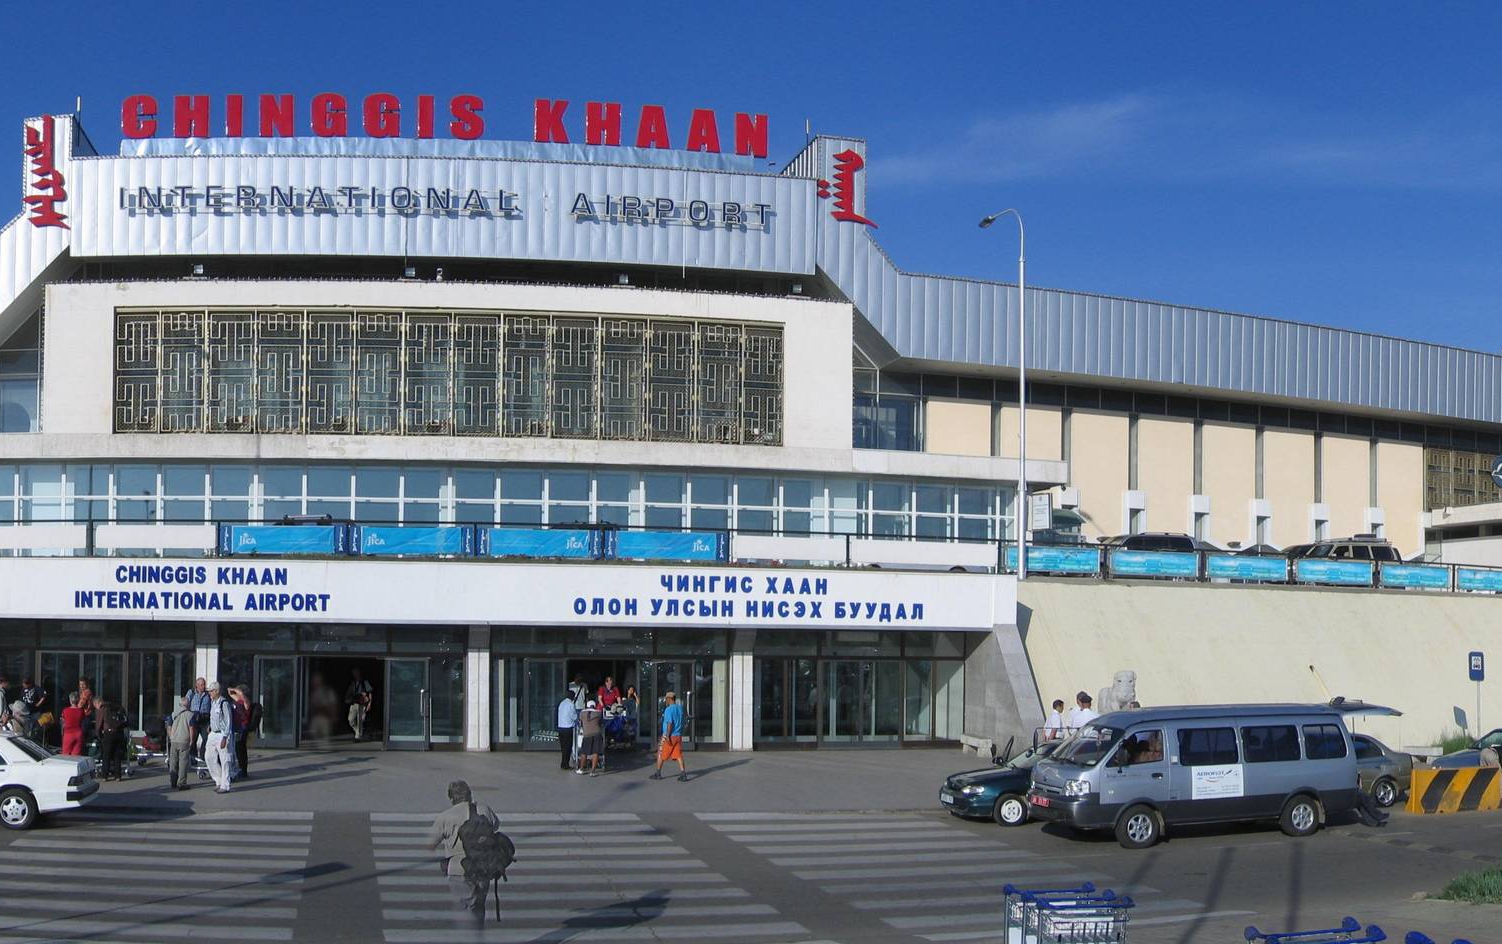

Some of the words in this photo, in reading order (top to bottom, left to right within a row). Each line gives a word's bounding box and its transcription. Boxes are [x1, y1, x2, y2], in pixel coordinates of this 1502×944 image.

[121, 92, 486, 141] CHINGGIS
[533, 98, 769, 158] KHAAN
[119, 185, 517, 212] INTERNATIONAL
[571, 191, 772, 226] AIRPORT
[115, 565, 207, 584] CHINGGIS
[217, 567, 288, 586] KHAAN
[660, 574, 753, 594] ЧИНГИС
[765, 576, 828, 596] ХААН
[74, 590, 234, 611] INTERNATIONAL
[244, 593, 331, 612] AIRPORT
[573, 597, 638, 616] ОЛОН
[650, 599, 734, 617] УЛСЫН
[746, 600, 823, 619] НИСЭХ
[834, 601, 924, 623] БУУДАЛ
